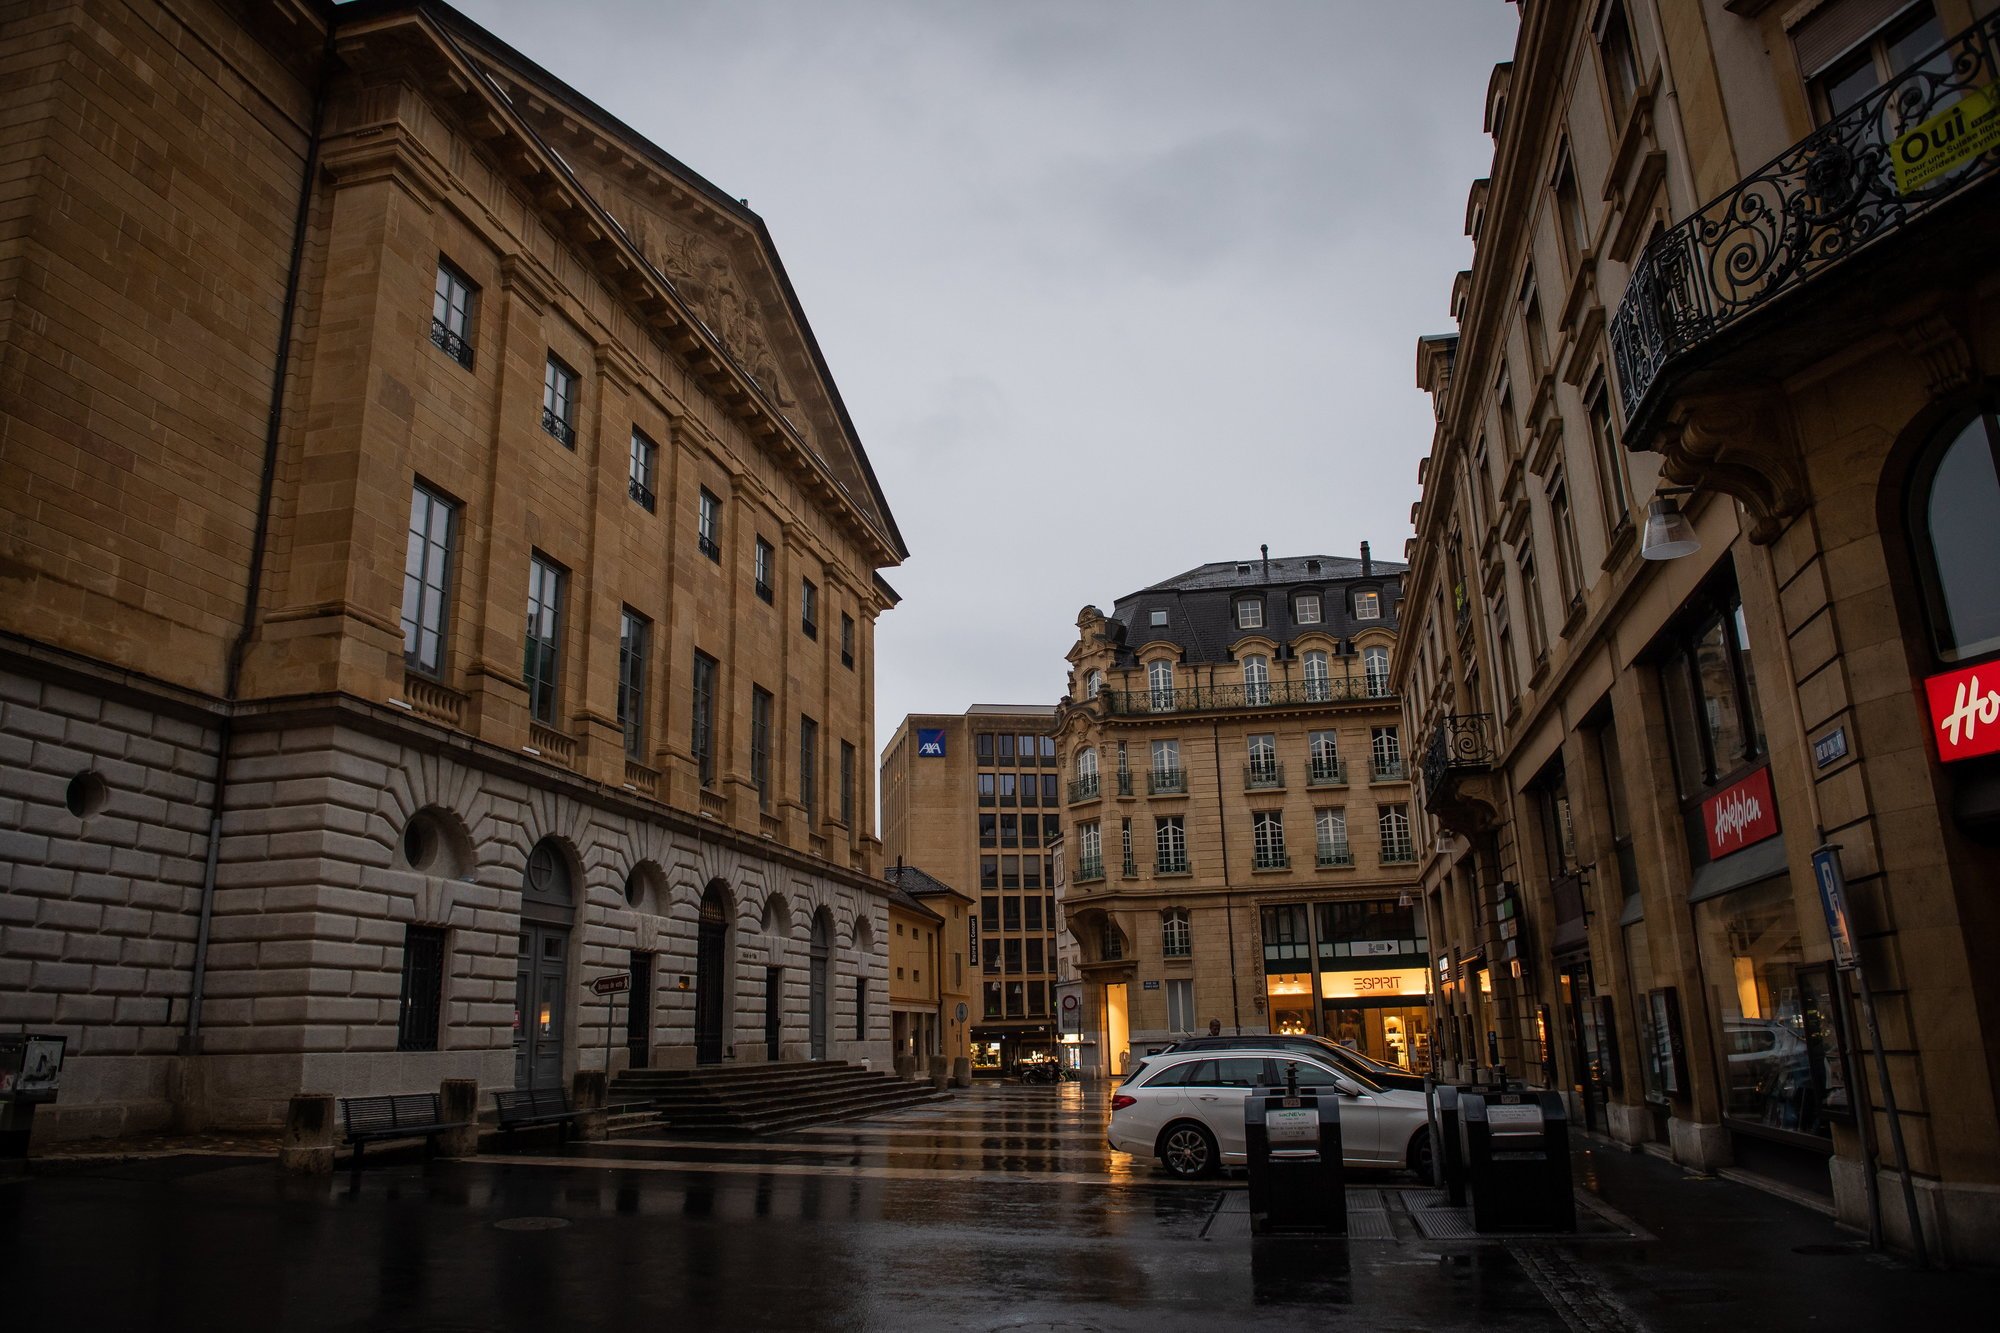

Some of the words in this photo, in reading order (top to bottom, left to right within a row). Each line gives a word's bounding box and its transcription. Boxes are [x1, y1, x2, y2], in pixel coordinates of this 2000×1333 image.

[1901, 107, 1965, 164] Oui
[1904, 162, 1926, 177] Pour
[1928, 151, 1946, 165] une
[1947, 132, 1979, 154] Suisse
[1906, 154, 1956, 186] pesticides
[1958, 145, 1970, 157] de
[918, 742, 942, 754] AXA
[1715, 788, 1762, 848] Hotelplan
[1353, 976, 1402, 990] ESPRIT
